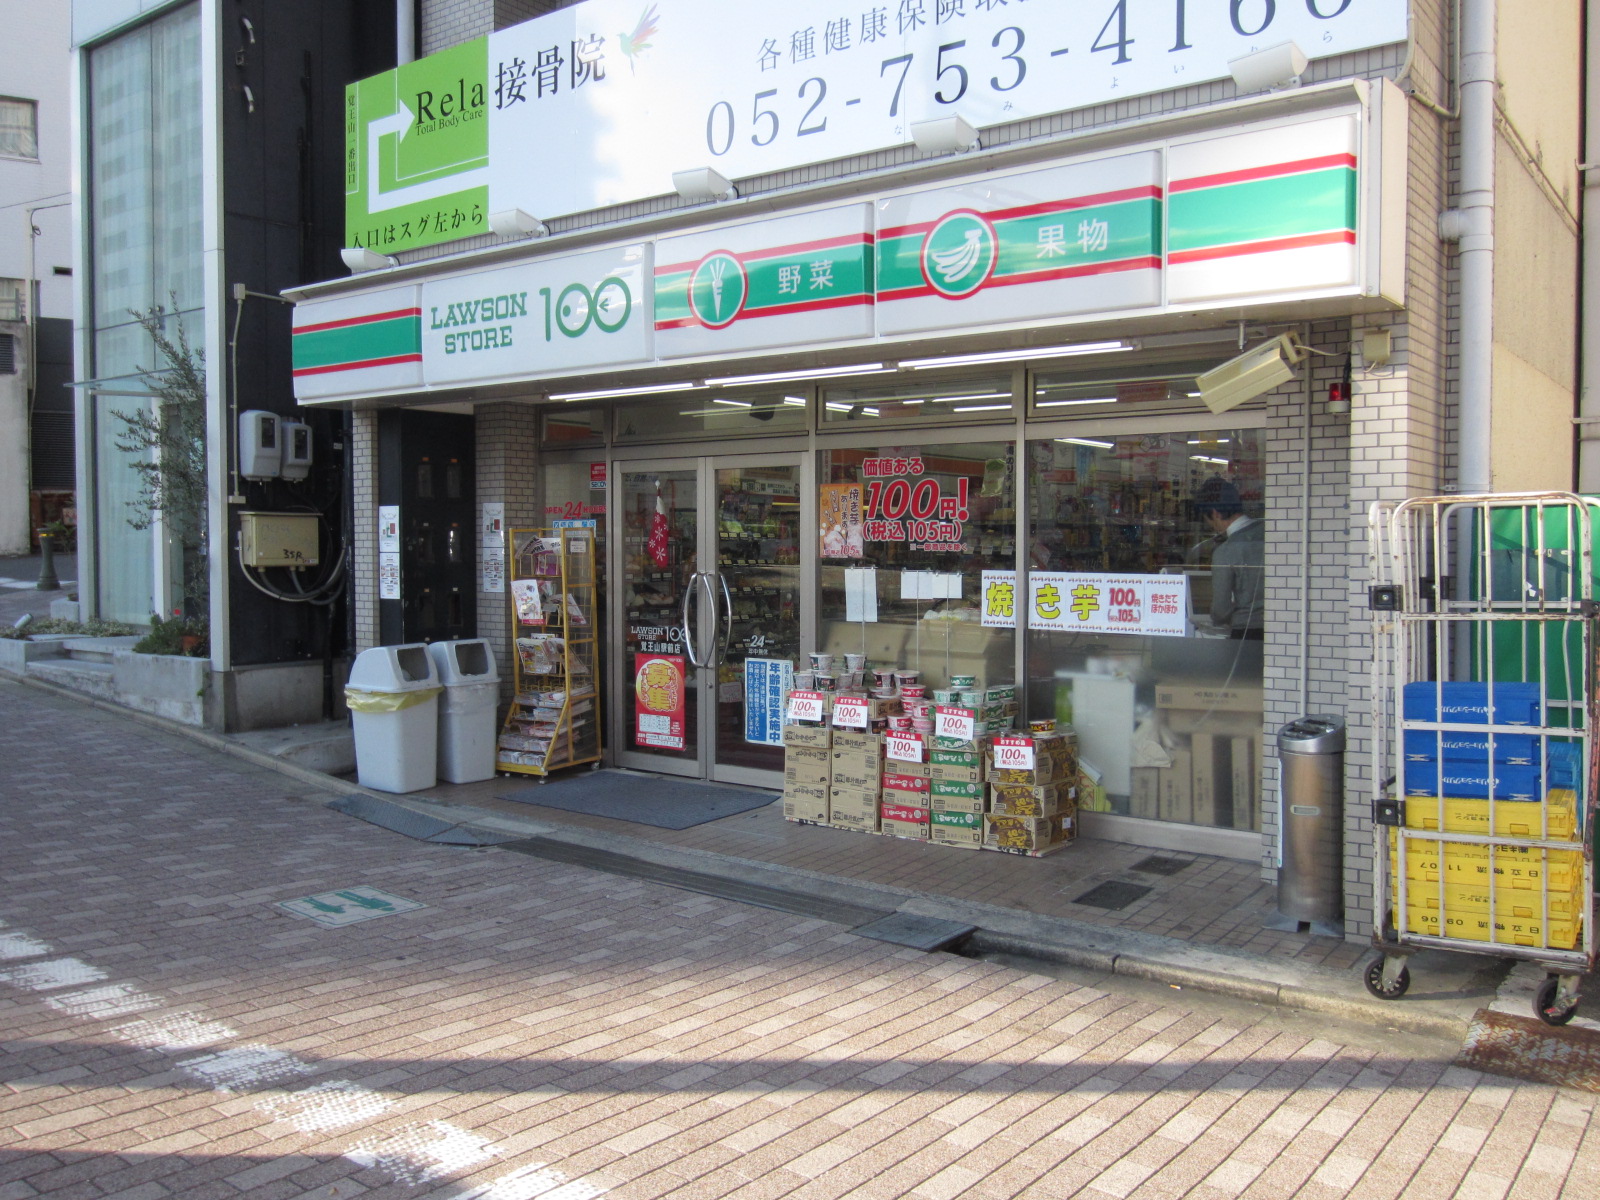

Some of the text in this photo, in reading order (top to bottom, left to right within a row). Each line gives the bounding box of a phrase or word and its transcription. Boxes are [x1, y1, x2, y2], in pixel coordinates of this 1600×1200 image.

[494, 33, 606, 110] 接骨院
[706, 0, 1351, 156] 052-753-416
[415, 78, 485, 125] Rela
[415, 107, 483, 136] Total Body Care
[353, 204, 483, 249] 入口はスグ左から
[1036, 218, 1108, 258] 果物
[778, 259, 834, 295] 野菜
[430, 291, 528, 330] LAWSON
[539, 277, 632, 342] 100
[444, 325, 513, 355] STORE
[863, 457, 925, 477] 価値ある
[544, 506, 563, 514] OPEN
[563, 501, 584, 520] 24
[849, 489, 860, 525] 焼き芋
[863, 521, 963, 541] (税込105円)
[986, 582, 1100, 621] 焼き芋
[1109, 587, 1141, 607] 100円
[631, 626, 663, 635] LAWSON
[750, 634, 765, 648] 24
[768, 662, 781, 742] 年齢確認実施中
[793, 701, 816, 711] 100円
[838, 707, 861, 717] 100円
[942, 717, 967, 730] 100円
[892, 741, 916, 752] 100円
[1000, 748, 1026, 759] 100円
[1476, 865, 1538, 877] 日立物流
[1478, 920, 1539, 934] 日立物流
